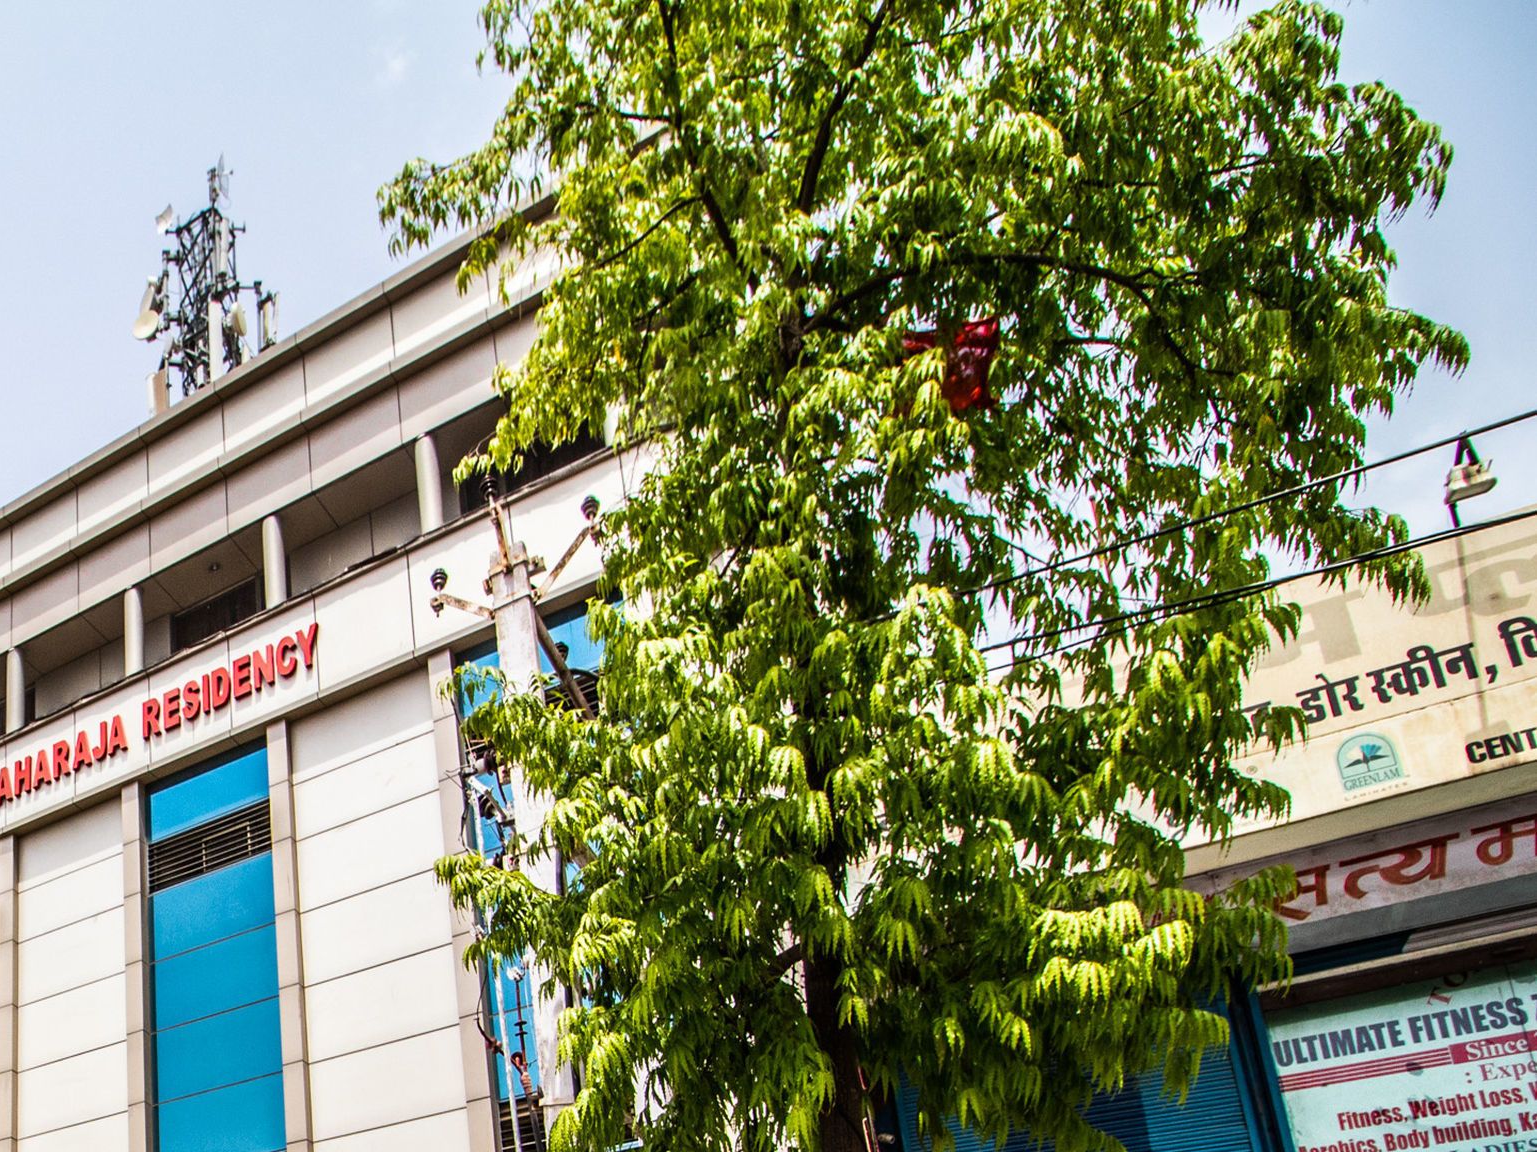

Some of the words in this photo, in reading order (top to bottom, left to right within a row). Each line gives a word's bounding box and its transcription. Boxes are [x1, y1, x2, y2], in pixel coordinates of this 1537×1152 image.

[142, 623, 319, 739] RESIDENCY
[1343, 767, 1400, 791] GREENLAM
[1272, 1020, 1406, 1067] ULTIMATE
[1407, 997, 1529, 1044] FITNESS
[1465, 1037, 1529, 1062] Since
[1337, 1105, 1409, 1131] Fitness,
[1408, 1091, 1476, 1120] Weight
[1478, 1086, 1528, 1110] Loss,
[1384, 1128, 1430, 1151] Body
[1433, 1116, 1518, 1146] building,
